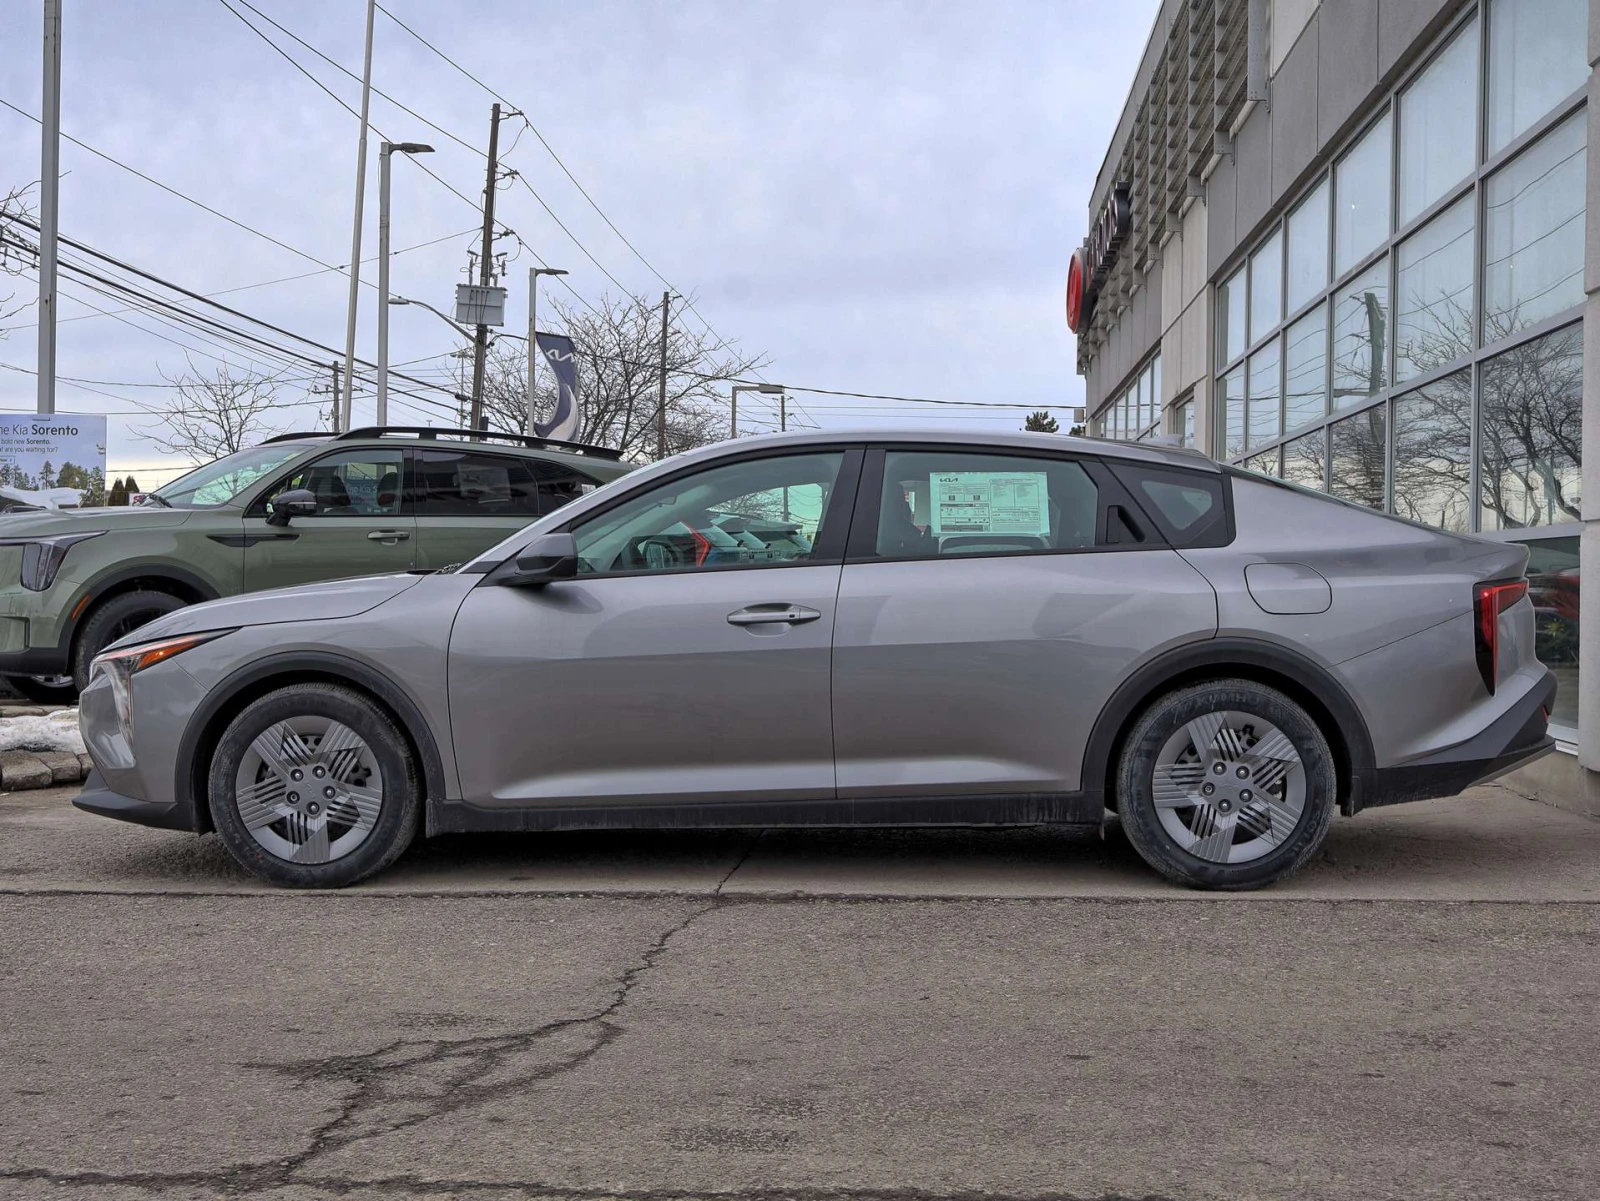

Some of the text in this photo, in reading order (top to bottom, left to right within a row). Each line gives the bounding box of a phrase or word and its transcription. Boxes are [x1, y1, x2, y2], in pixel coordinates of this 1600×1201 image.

[13, 424, 28, 436] Kia
[31, 424, 78, 436] Sorento
[25, 446, 45, 454] waiting
